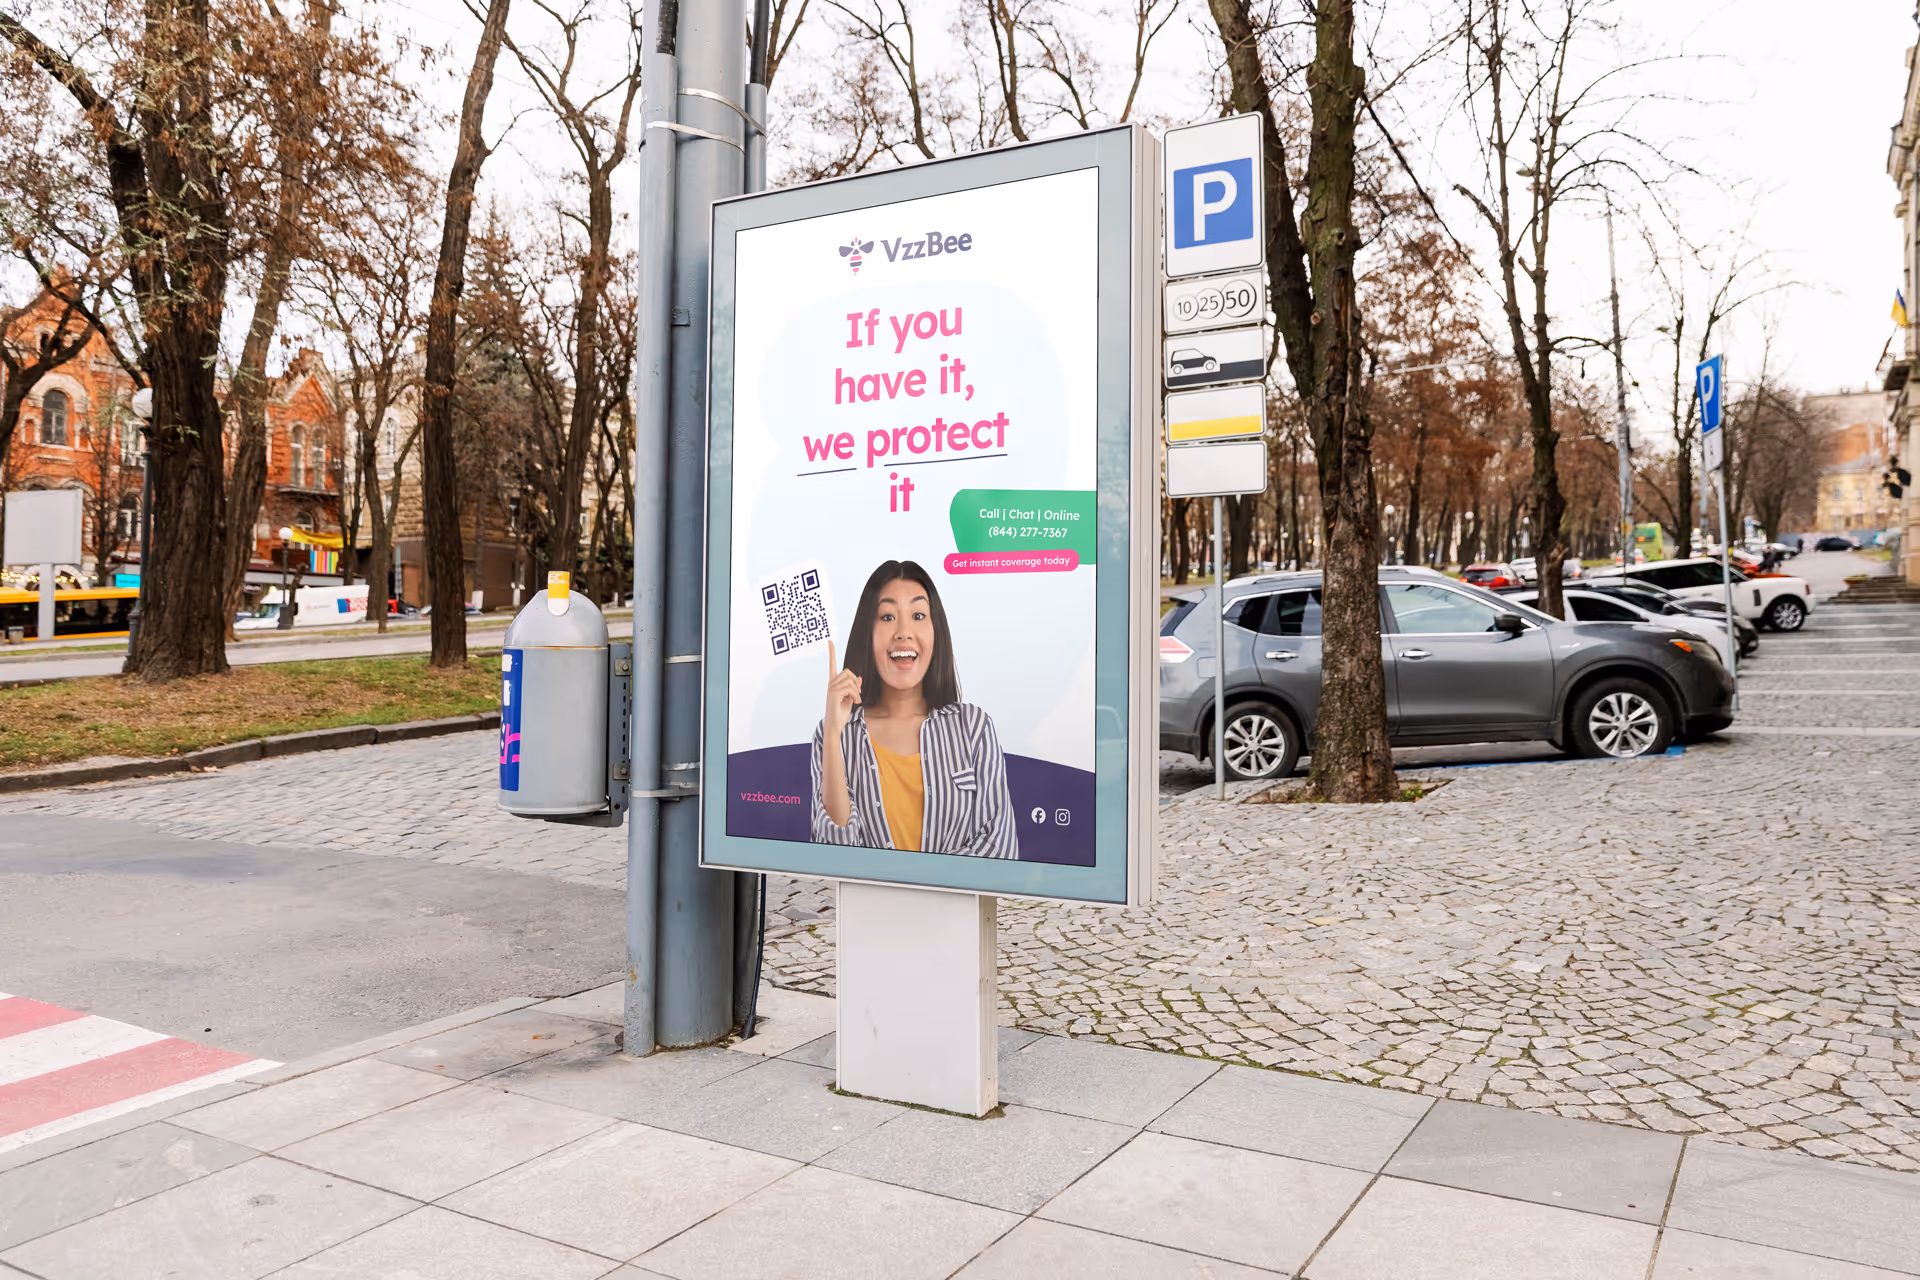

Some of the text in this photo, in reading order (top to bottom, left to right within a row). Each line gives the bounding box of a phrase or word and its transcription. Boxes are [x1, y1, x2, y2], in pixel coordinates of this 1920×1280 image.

[1193, 170, 1237, 241] P
[880, 231, 972, 263] VzzBee
[1177, 289, 1250, 315] 10 25 50
[846, 306, 963, 354] If you
[835, 353, 974, 404] have it,
[1700, 366, 1715, 425] P
[803, 411, 1009, 468] we protect
[889, 472, 915, 512] it
[979, 508, 1000, 519] Call
[1009, 509, 1034, 520] Chat
[1044, 509, 1080, 521] Online
[988, 526, 1068, 538] (844) 277-7367
[952, 556, 1071, 568] Get instant coverage today
[740, 791, 801, 805] vzzbee.com
